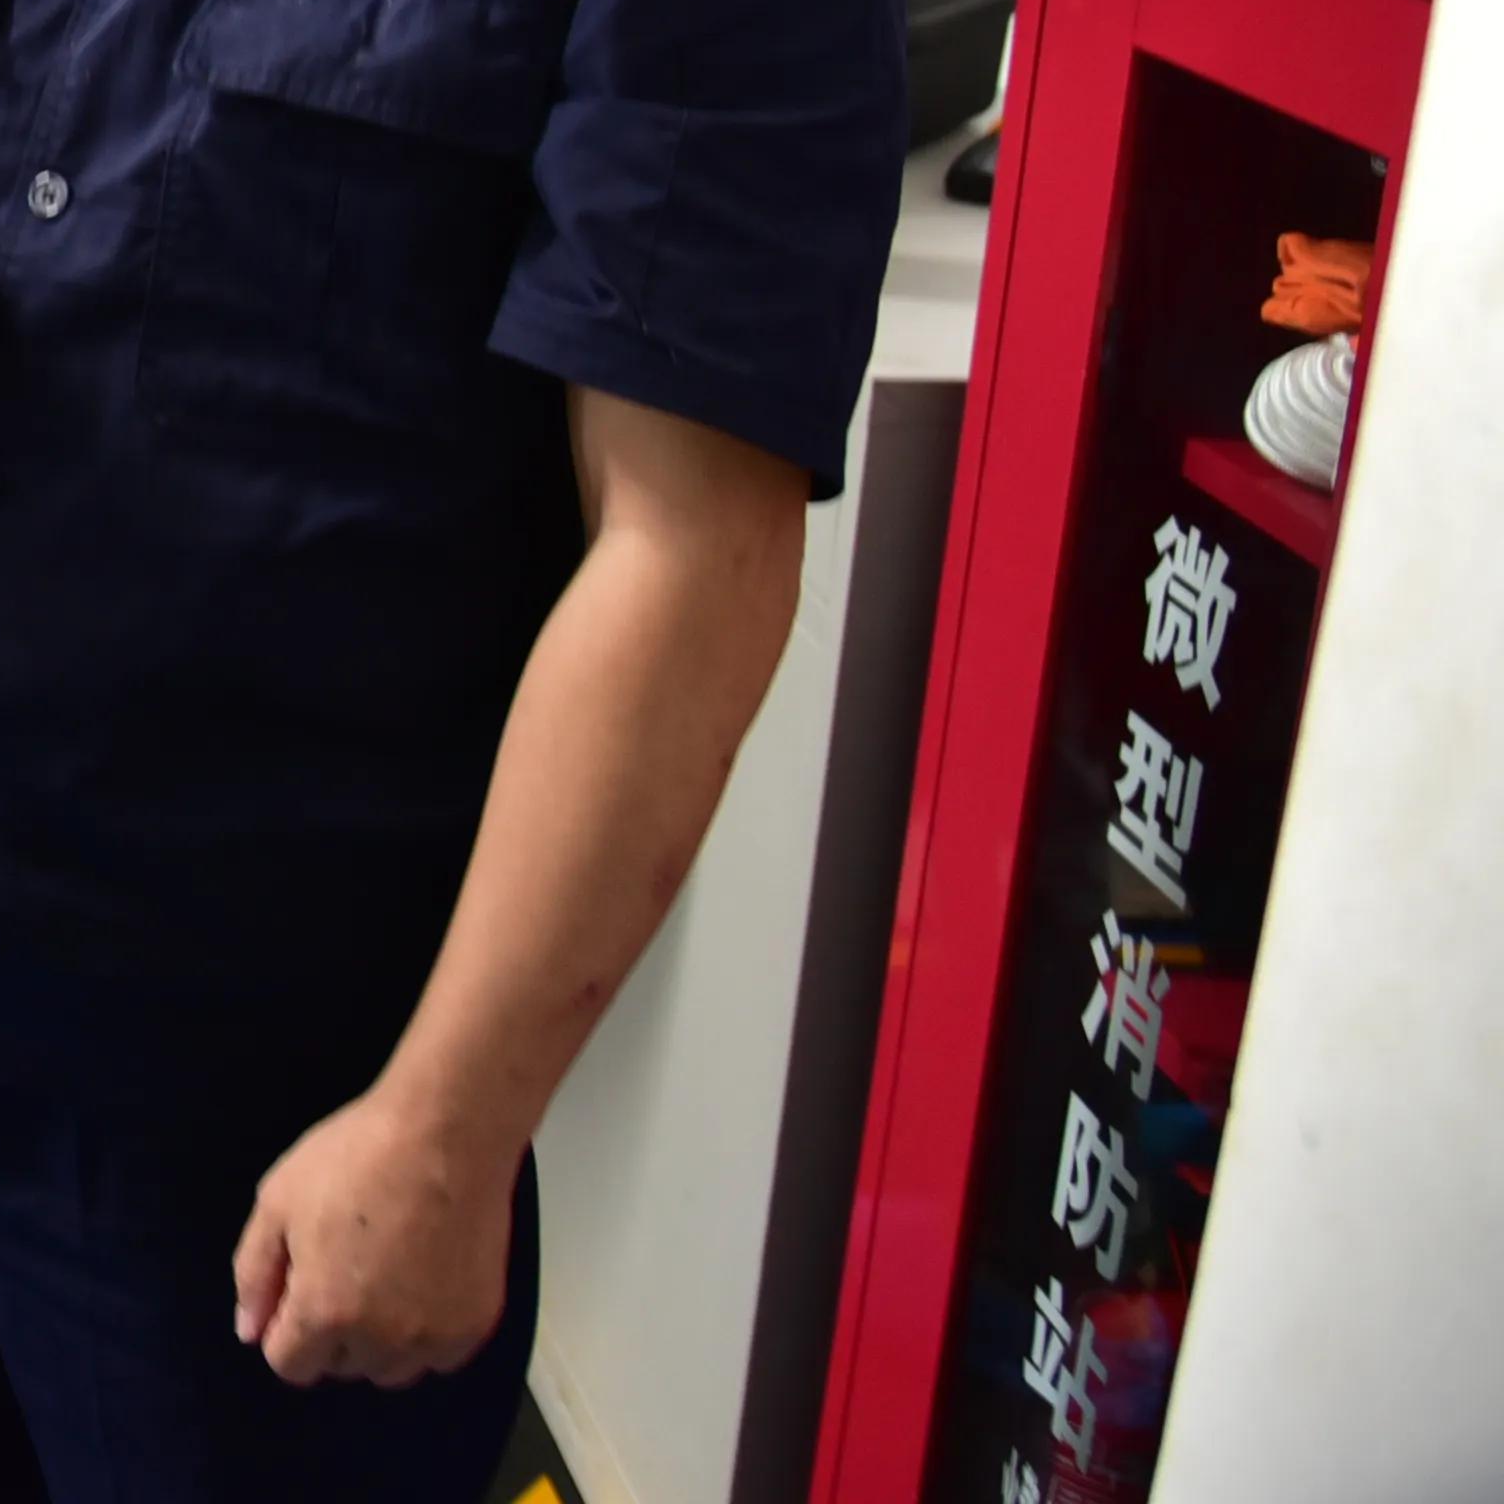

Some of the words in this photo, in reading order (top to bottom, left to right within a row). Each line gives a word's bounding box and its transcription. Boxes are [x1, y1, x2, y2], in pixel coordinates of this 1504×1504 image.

[1022, 514, 1238, 1474] 微型消防站
